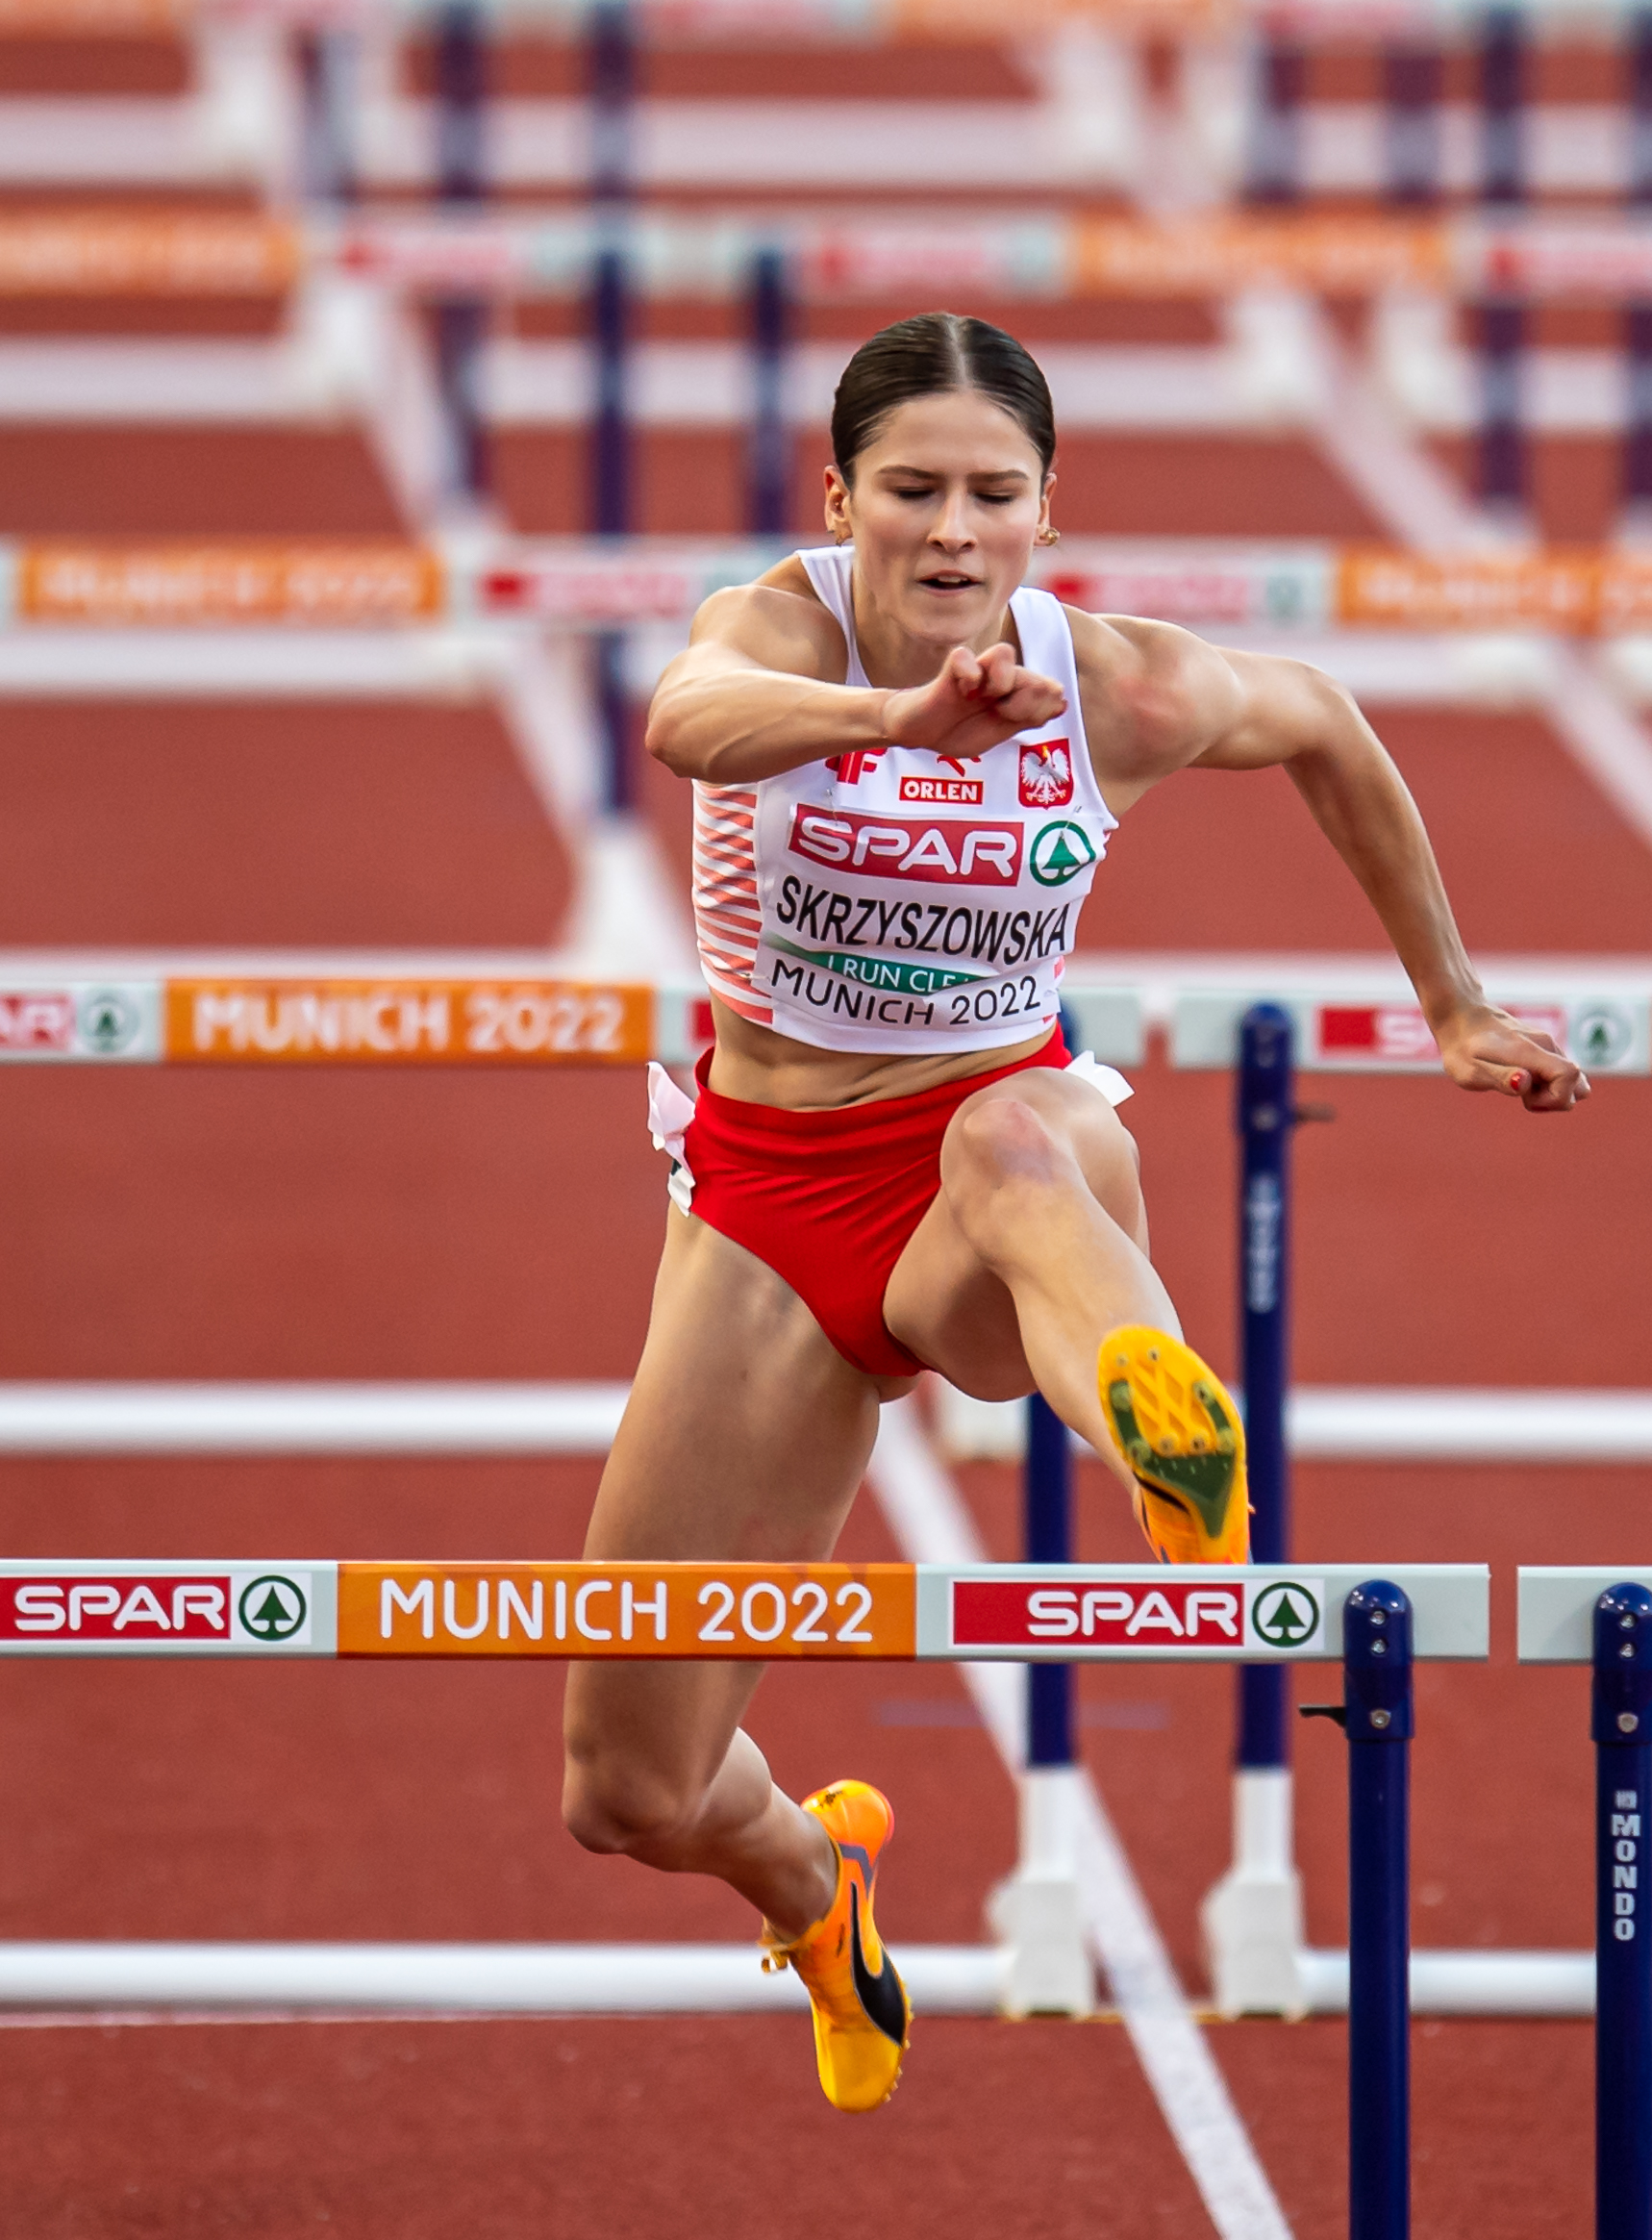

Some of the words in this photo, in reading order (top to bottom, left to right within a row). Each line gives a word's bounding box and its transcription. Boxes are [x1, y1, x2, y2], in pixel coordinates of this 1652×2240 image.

[904, 780, 978, 801] ORLEN
[799, 816, 1017, 876] SPAR
[776, 875, 1069, 965] SKRZYSZOWSKA
[770, 958, 935, 1026] MUNICH
[950, 974, 1041, 1026] 2022
[842, 958, 902, 988] RUN
[909, 970, 970, 993] CLE
[193, 992, 450, 1051] MUNICH
[468, 992, 625, 1050] 2022
[14, 1585, 224, 1631] SPAR
[380, 1578, 667, 1641] MUNICH
[697, 1582, 873, 1643] 2022
[1026, 1591, 1239, 1637] SPAR
[1611, 1814, 1641, 1941] MONDO
